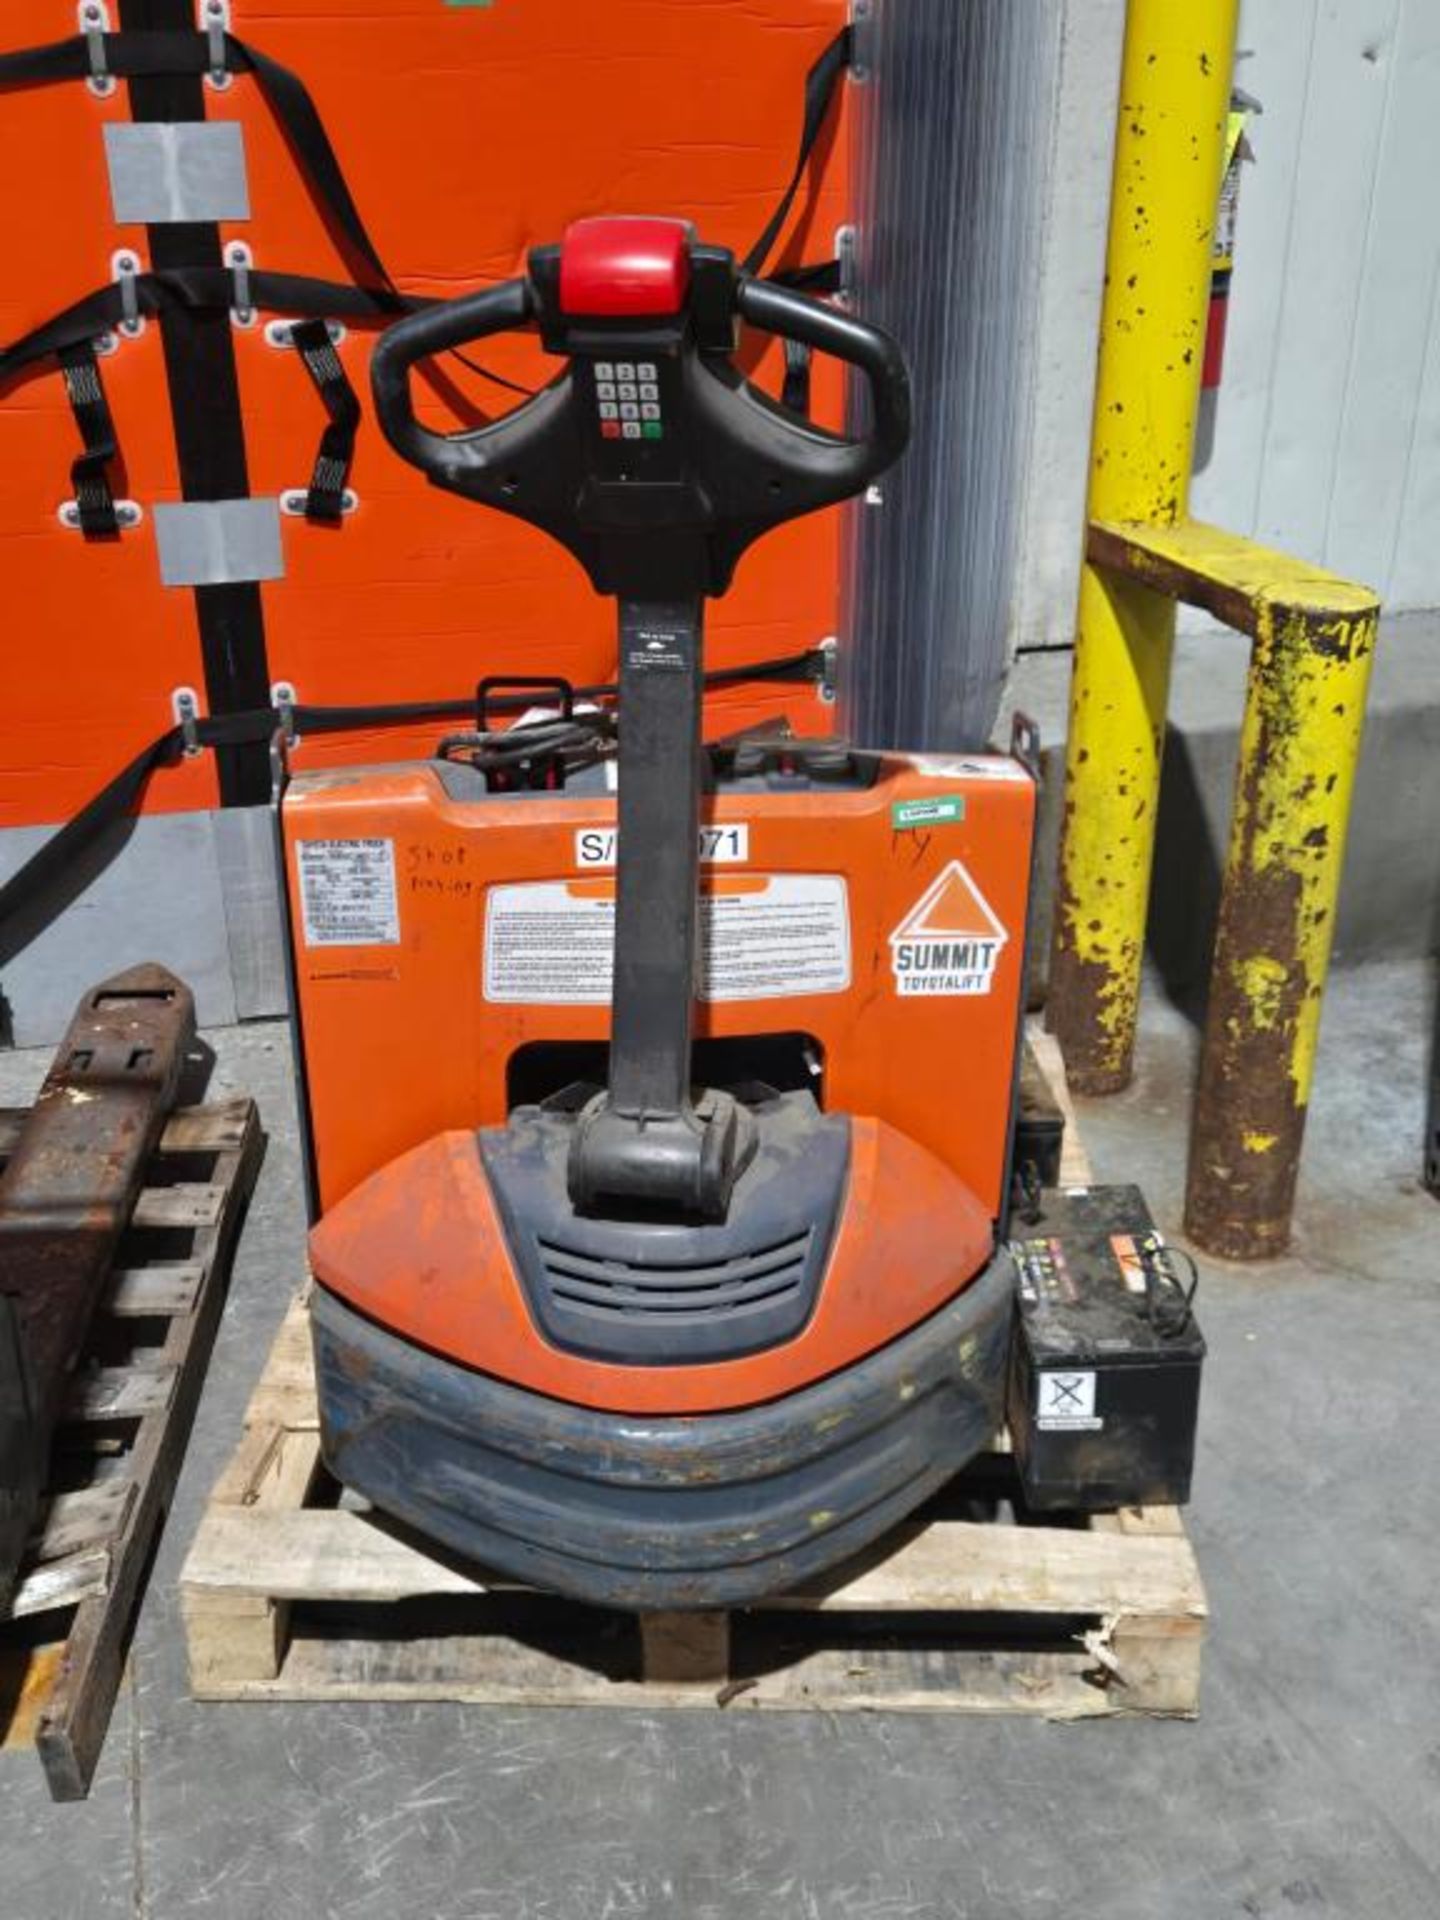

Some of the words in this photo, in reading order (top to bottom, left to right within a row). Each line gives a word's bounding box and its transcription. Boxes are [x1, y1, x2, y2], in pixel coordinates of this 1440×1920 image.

[700, 830, 740, 857] 71
[897, 943, 996, 971] SUMMIT
[904, 975, 983, 990] TOYOTALIFT
